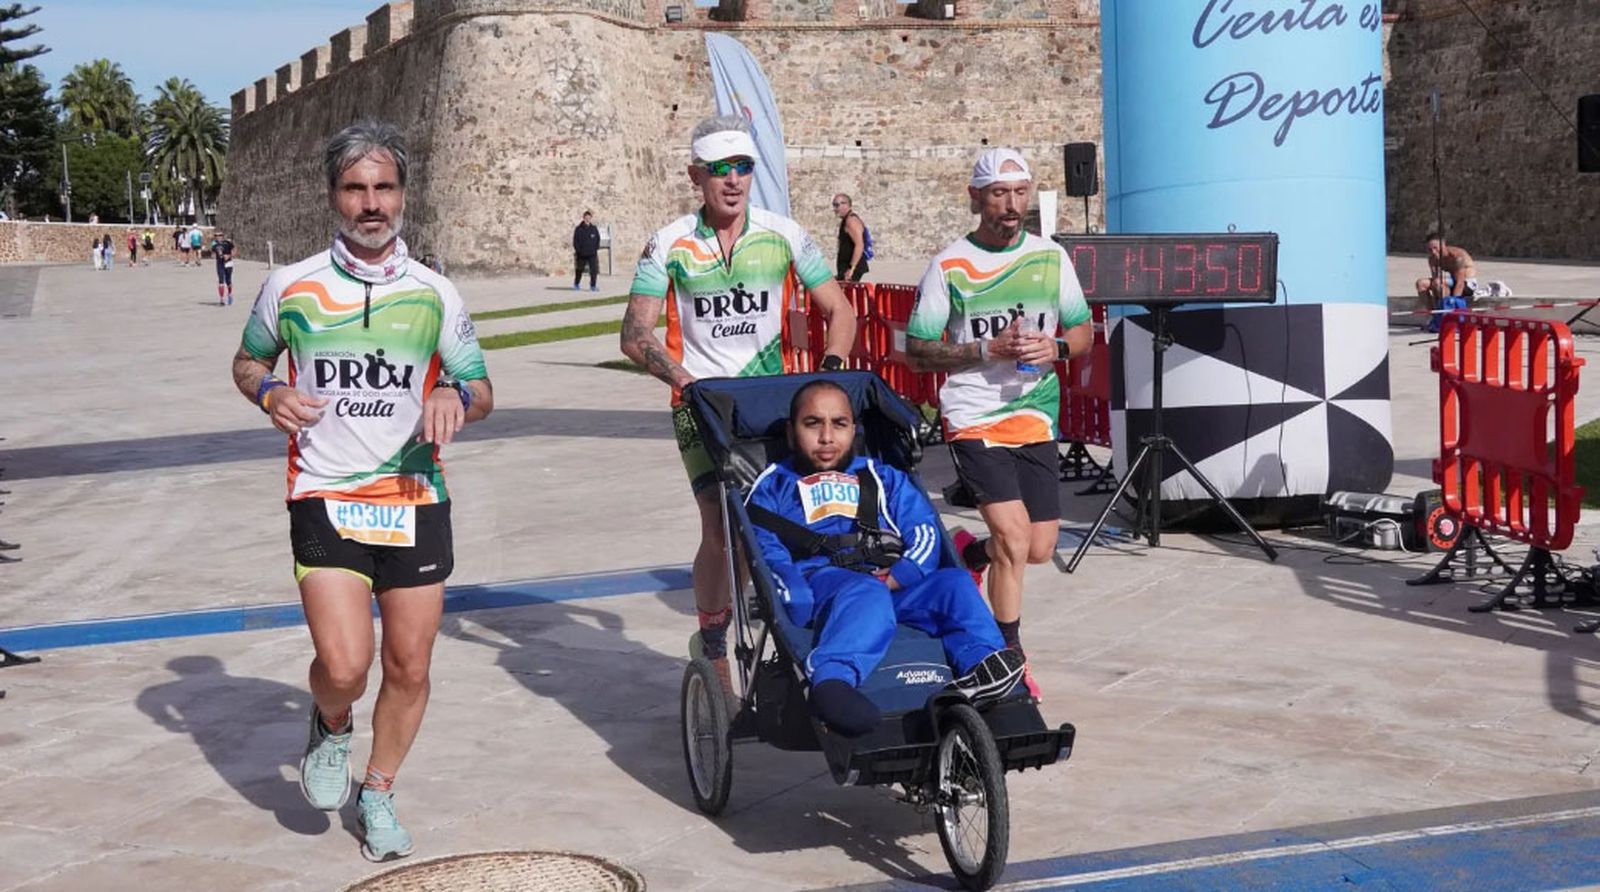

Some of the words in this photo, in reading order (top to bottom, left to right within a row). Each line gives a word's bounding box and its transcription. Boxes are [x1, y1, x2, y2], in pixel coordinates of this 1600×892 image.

[1192, 0, 1348, 48] Ceuta
[1359, 4, 1381, 32] es
[1204, 72, 1382, 147] Deporte
[711, 321, 757, 338] Ceuta
[336, 397, 395, 417] Ceuta
[337, 503, 406, 529] #0302
